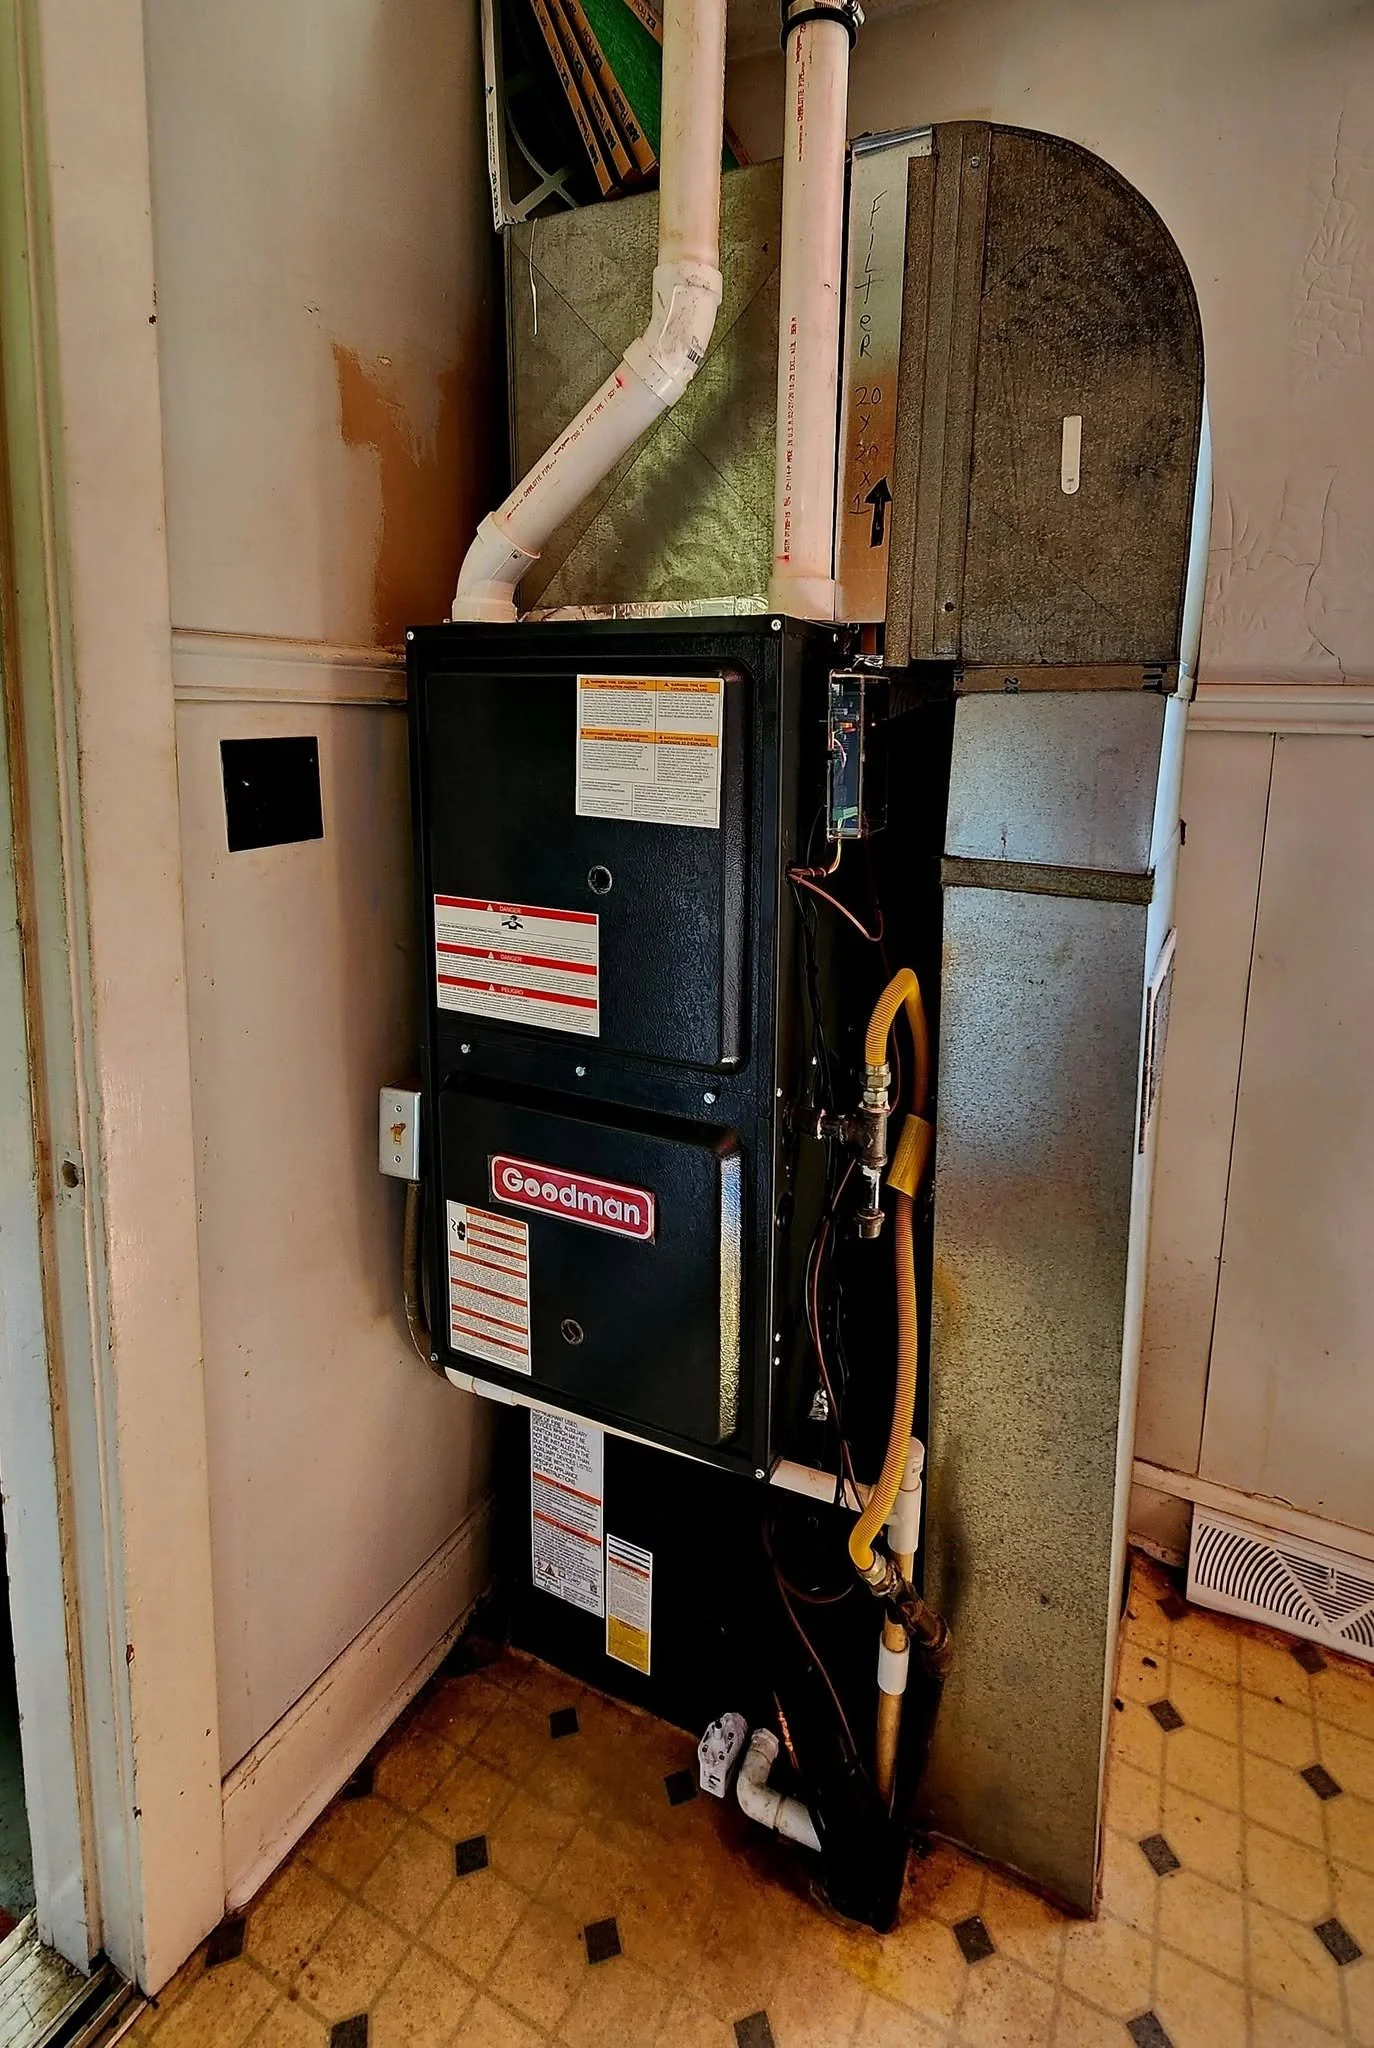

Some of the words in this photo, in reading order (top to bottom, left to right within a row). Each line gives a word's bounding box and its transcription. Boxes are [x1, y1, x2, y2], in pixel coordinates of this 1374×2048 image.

[855, 387, 881, 406] 20
[499, 905, 521, 914] DANGER
[500, 954, 522, 963] DANGER
[501, 987, 523, 995] PELIGRO
[501, 1167, 641, 1226] Goodman
